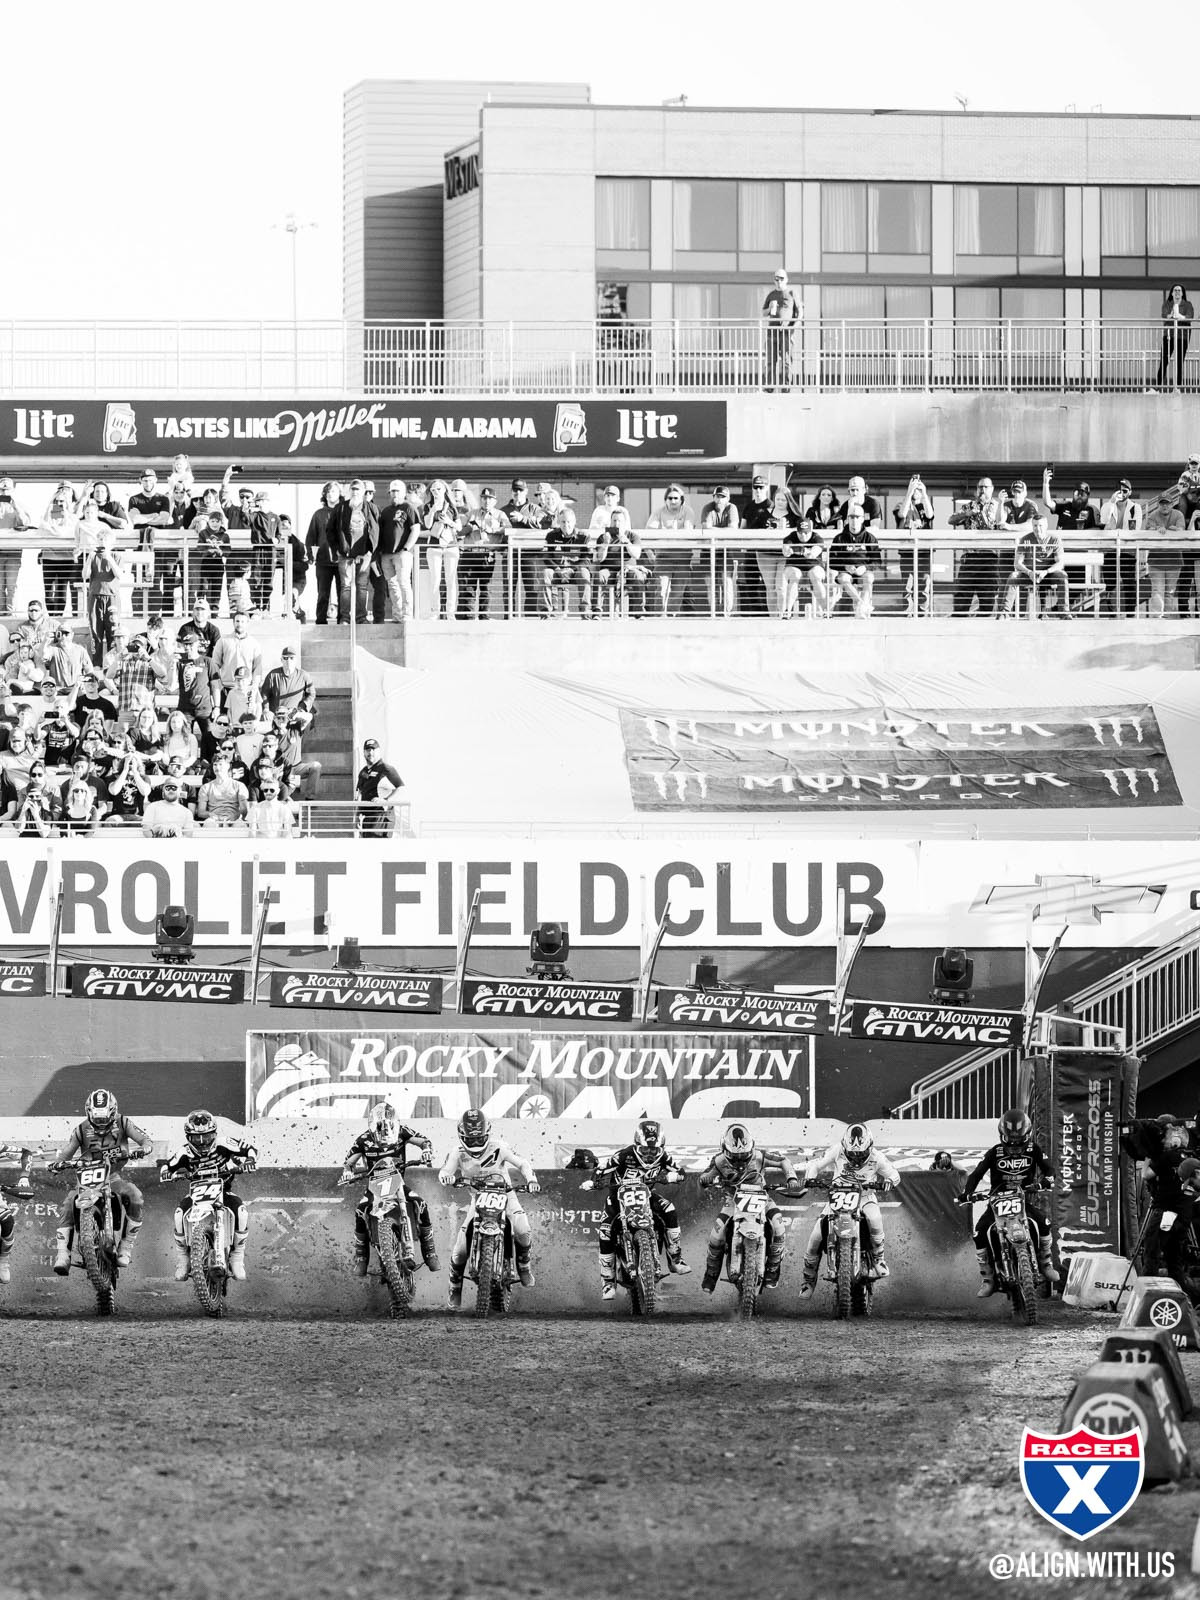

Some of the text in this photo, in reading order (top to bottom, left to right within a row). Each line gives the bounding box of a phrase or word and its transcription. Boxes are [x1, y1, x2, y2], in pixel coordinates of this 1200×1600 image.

[13, 408, 75, 447] Lite
[153, 402, 537, 453] TASTES LIKE Miller TIME, ALABAMA
[616, 408, 678, 447] Lite
[381, 861, 630, 936] FIELD
[653, 861, 887, 937] CLUB
[106, 966, 234, 983] ROCKY MOUNTAIN
[305, 974, 431, 991] ROCKY MOUNTAIN
[495, 983, 622, 1001] ROCKY MOUNTAIN
[692, 992, 819, 1013] ROCKY MOUNTAIN
[886, 1006, 1013, 1027] ROCKY MOUNTAIN
[339, 1038, 803, 1081] ROCKY MOUNTAIN
[1061, 1112, 1075, 1192] MONSTER
[1087, 1079, 1100, 1226] SUPERCROSS
[1103, 1111, 1112, 1196] CHAMPIONSHIP
[81, 1167, 106, 1185] 60
[377, 1177, 392, 1196] 1
[191, 1184, 222, 1200] 24
[623, 1190, 647, 1206] 83
[736, 1192, 768, 1213] 75
[829, 1191, 859, 1211] 39
[995, 1199, 1022, 1216] 125
